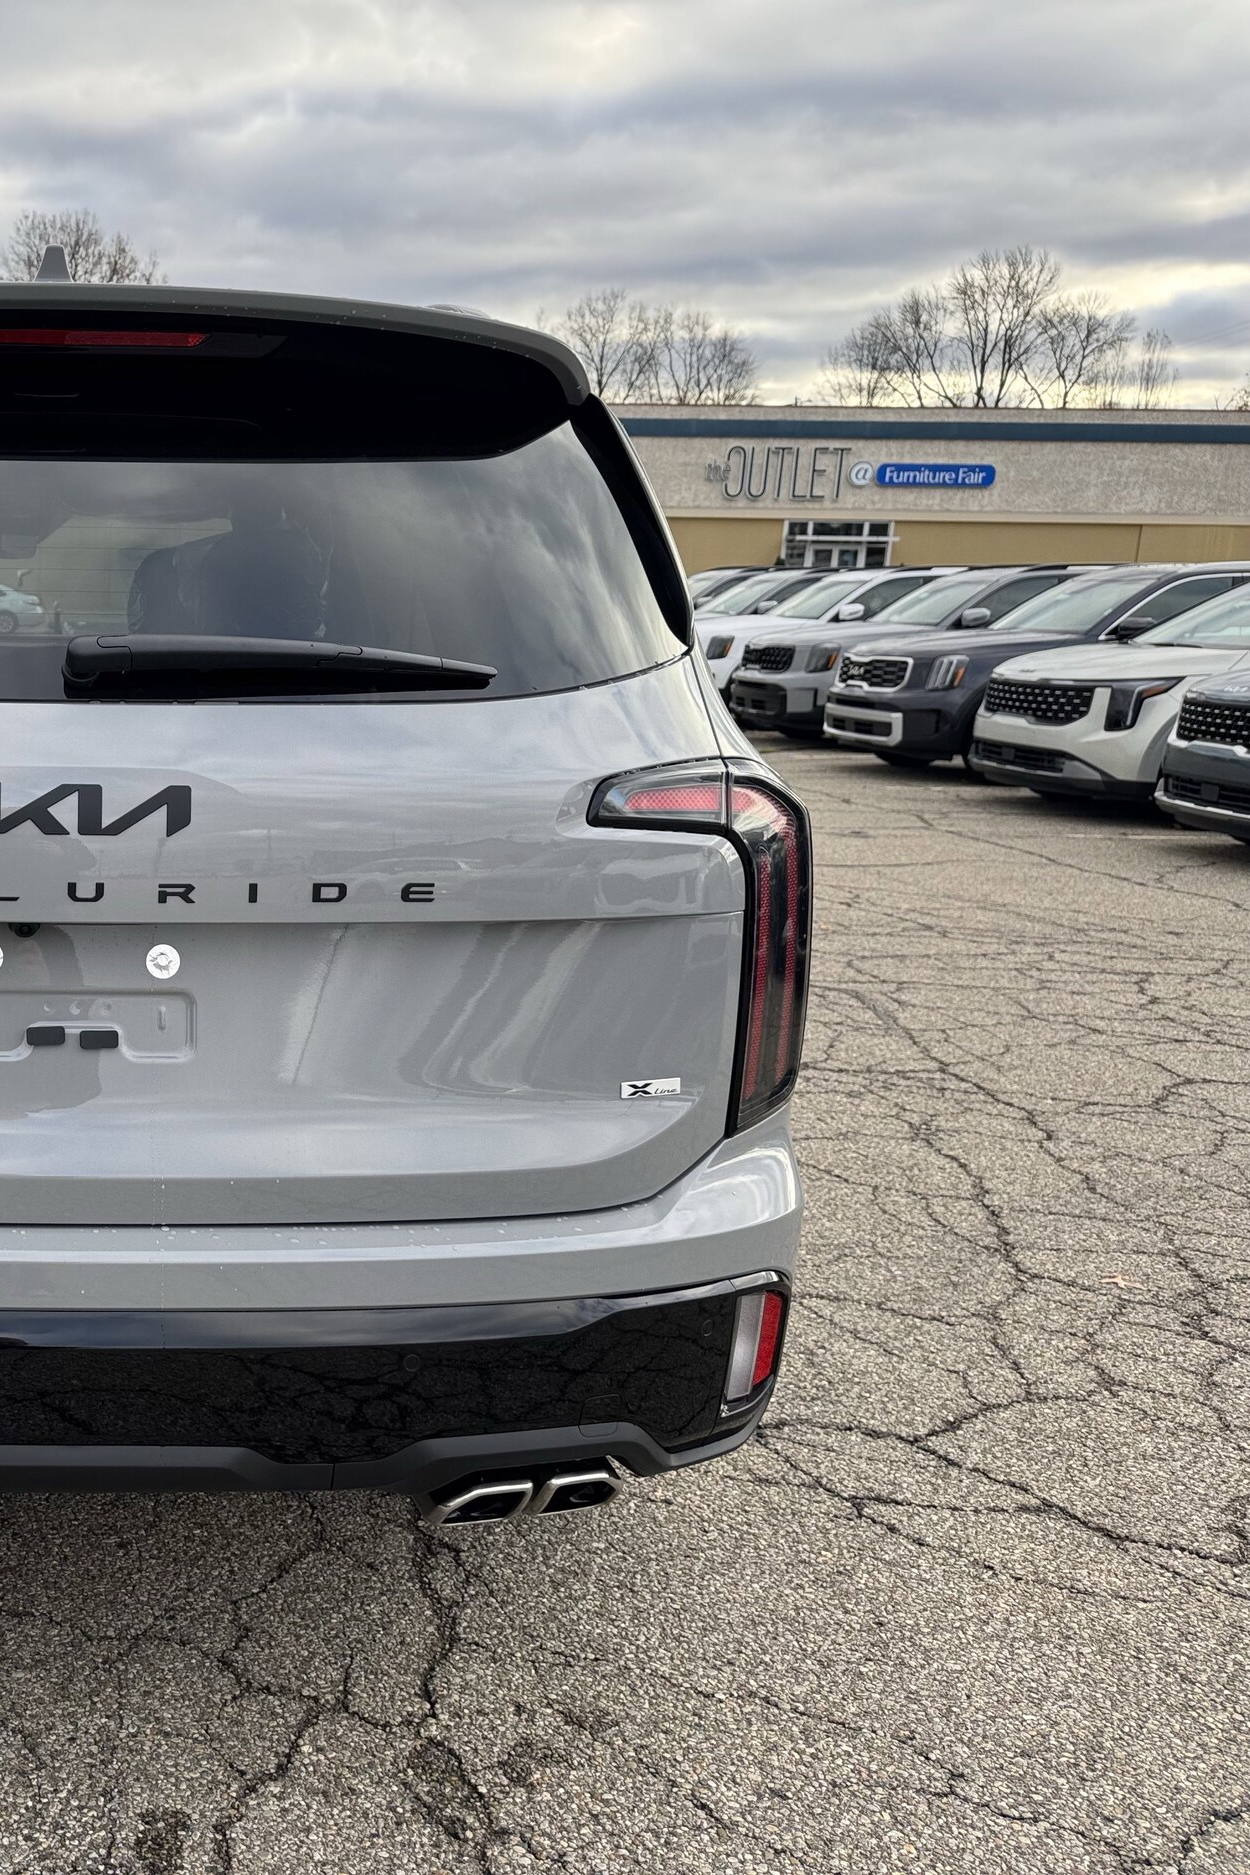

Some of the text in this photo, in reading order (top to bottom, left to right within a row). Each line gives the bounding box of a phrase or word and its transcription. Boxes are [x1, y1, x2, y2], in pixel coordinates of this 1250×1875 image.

[705, 445, 987, 499] the OUTLET @ Furniture Fair
[627, 1082, 653, 1097] X
